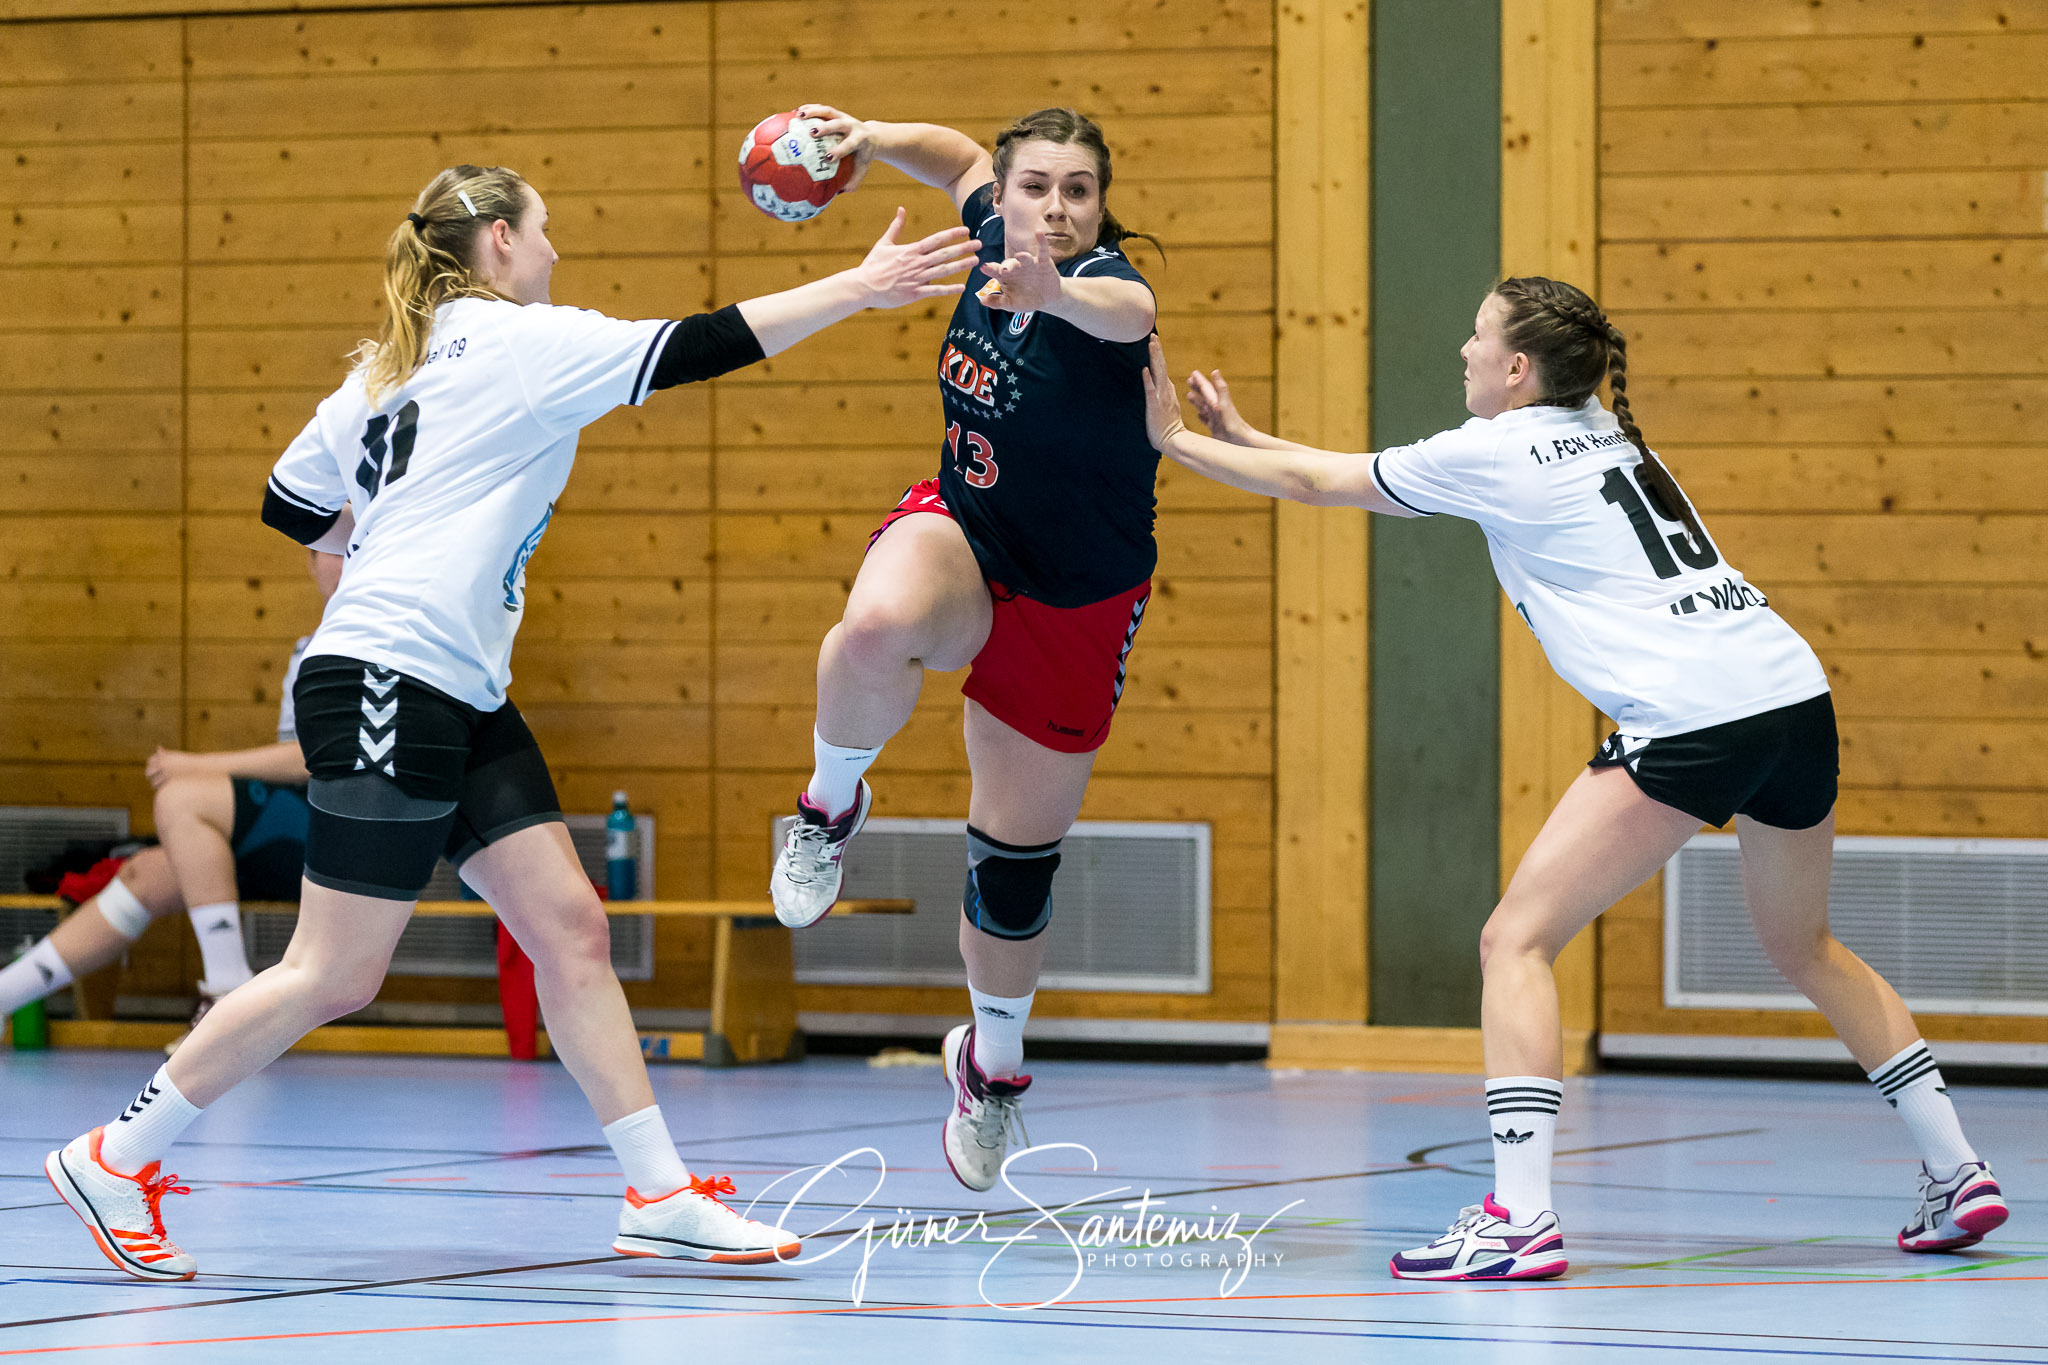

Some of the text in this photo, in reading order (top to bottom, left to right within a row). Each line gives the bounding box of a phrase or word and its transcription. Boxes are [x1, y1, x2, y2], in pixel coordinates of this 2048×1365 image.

[447, 337, 467, 359] 09
[939, 342, 998, 407] KDE
[946, 420, 999, 488] 13
[1529, 430, 1629, 465] 1. FCN Hand
[1599, 462, 1718, 580] 19
